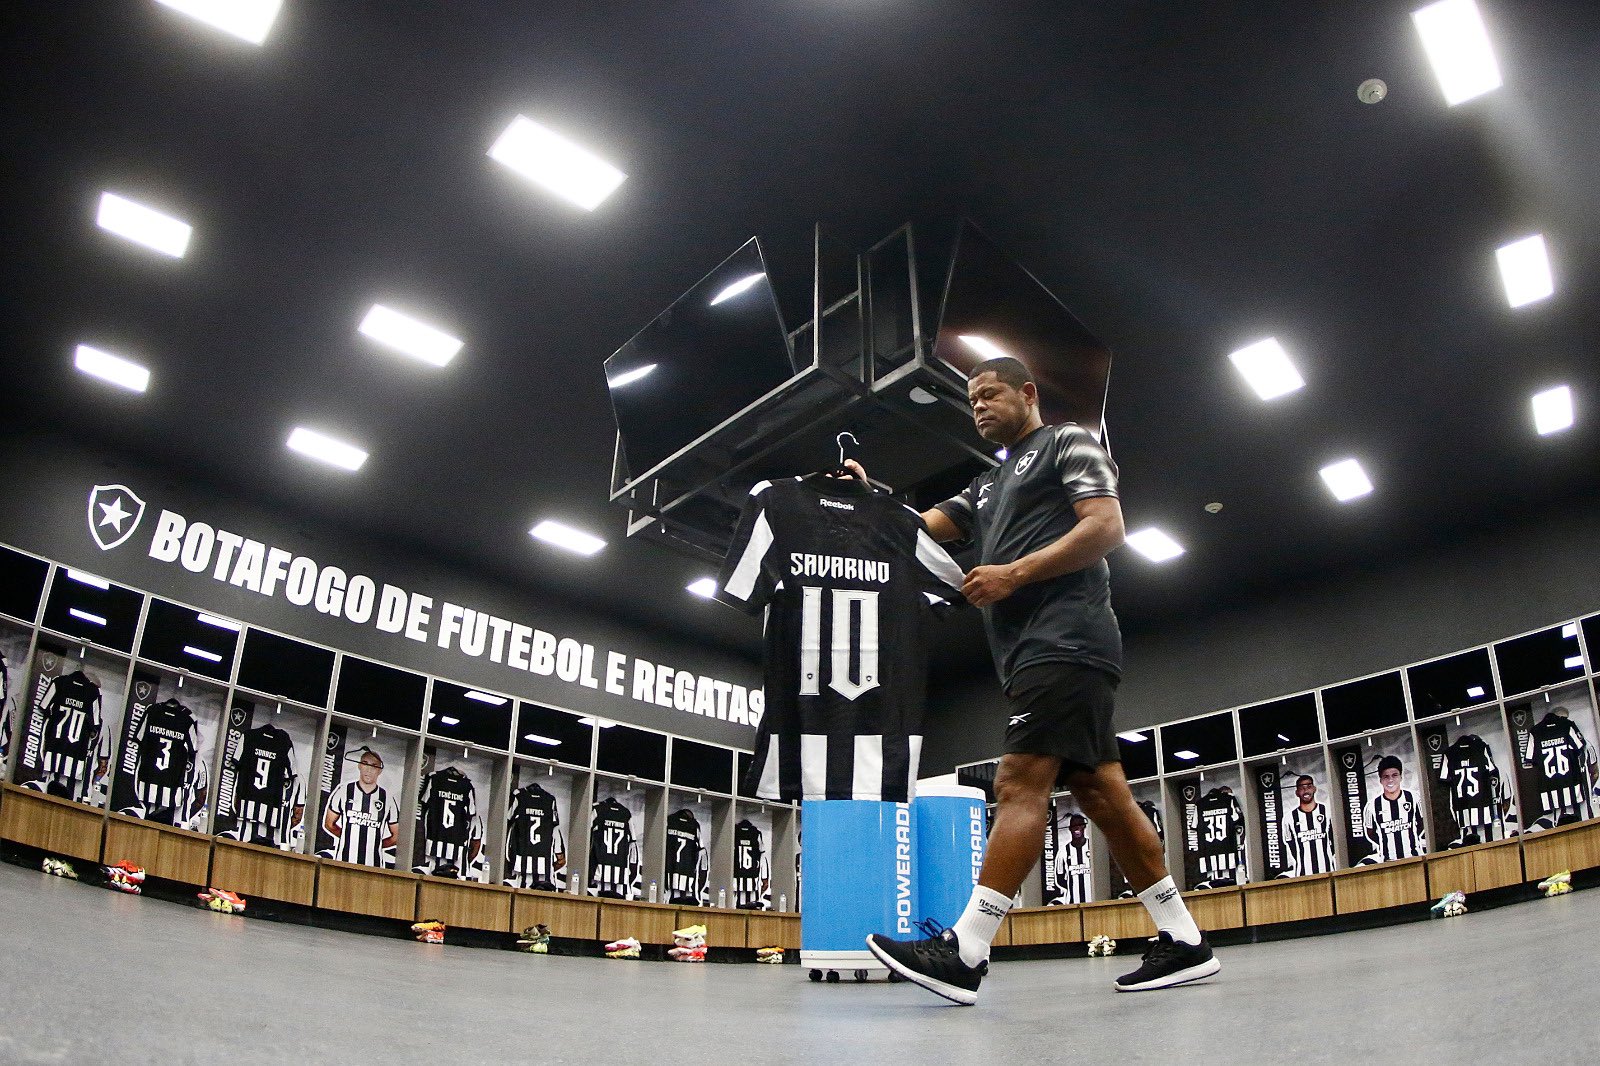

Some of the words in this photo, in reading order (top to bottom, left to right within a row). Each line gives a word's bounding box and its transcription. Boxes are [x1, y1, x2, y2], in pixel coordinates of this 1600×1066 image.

[820, 498, 855, 511] Reebok
[790, 553, 890, 584] SAVARINO
[149, 509, 375, 624] BOTAFOGO
[376, 584, 433, 643] DE
[437, 602, 598, 689] FUTEBOL
[605, 651, 626, 696] E
[632, 658, 765, 728] REGATAS
[799, 586, 881, 701] 10
[65, 697, 84, 709] OSCAR
[55, 705, 87, 744] 70
[23, 734, 41, 769] DIEGO
[123, 739, 140, 775] LUCAS
[155, 737, 173, 771] 3
[1541, 744, 1569, 779] 26
[253, 757, 271, 790] 9
[321, 753, 336, 793] MARÇAL
[1346, 771, 1359, 795] URSO
[1454, 766, 1479, 798] 75
[217, 769, 235, 817] TIQUINHO
[1264, 790, 1277, 821] MACIEL
[354, 818, 381, 829] MATCH
[442, 799, 457, 829] 6
[1204, 814, 1227, 843] 39
[1348, 796, 1363, 837] EMERSON
[529, 816, 541, 845] 2
[603, 827, 625, 855] 47
[1266, 822, 1280, 869] JEFFERSON
[676, 837, 687, 863] 7
[738, 845, 753, 870] 16
[1044, 849, 1054, 860] DE
[1045, 862, 1056, 891] PATRICK
[979, 898, 1007, 915] Reebo
